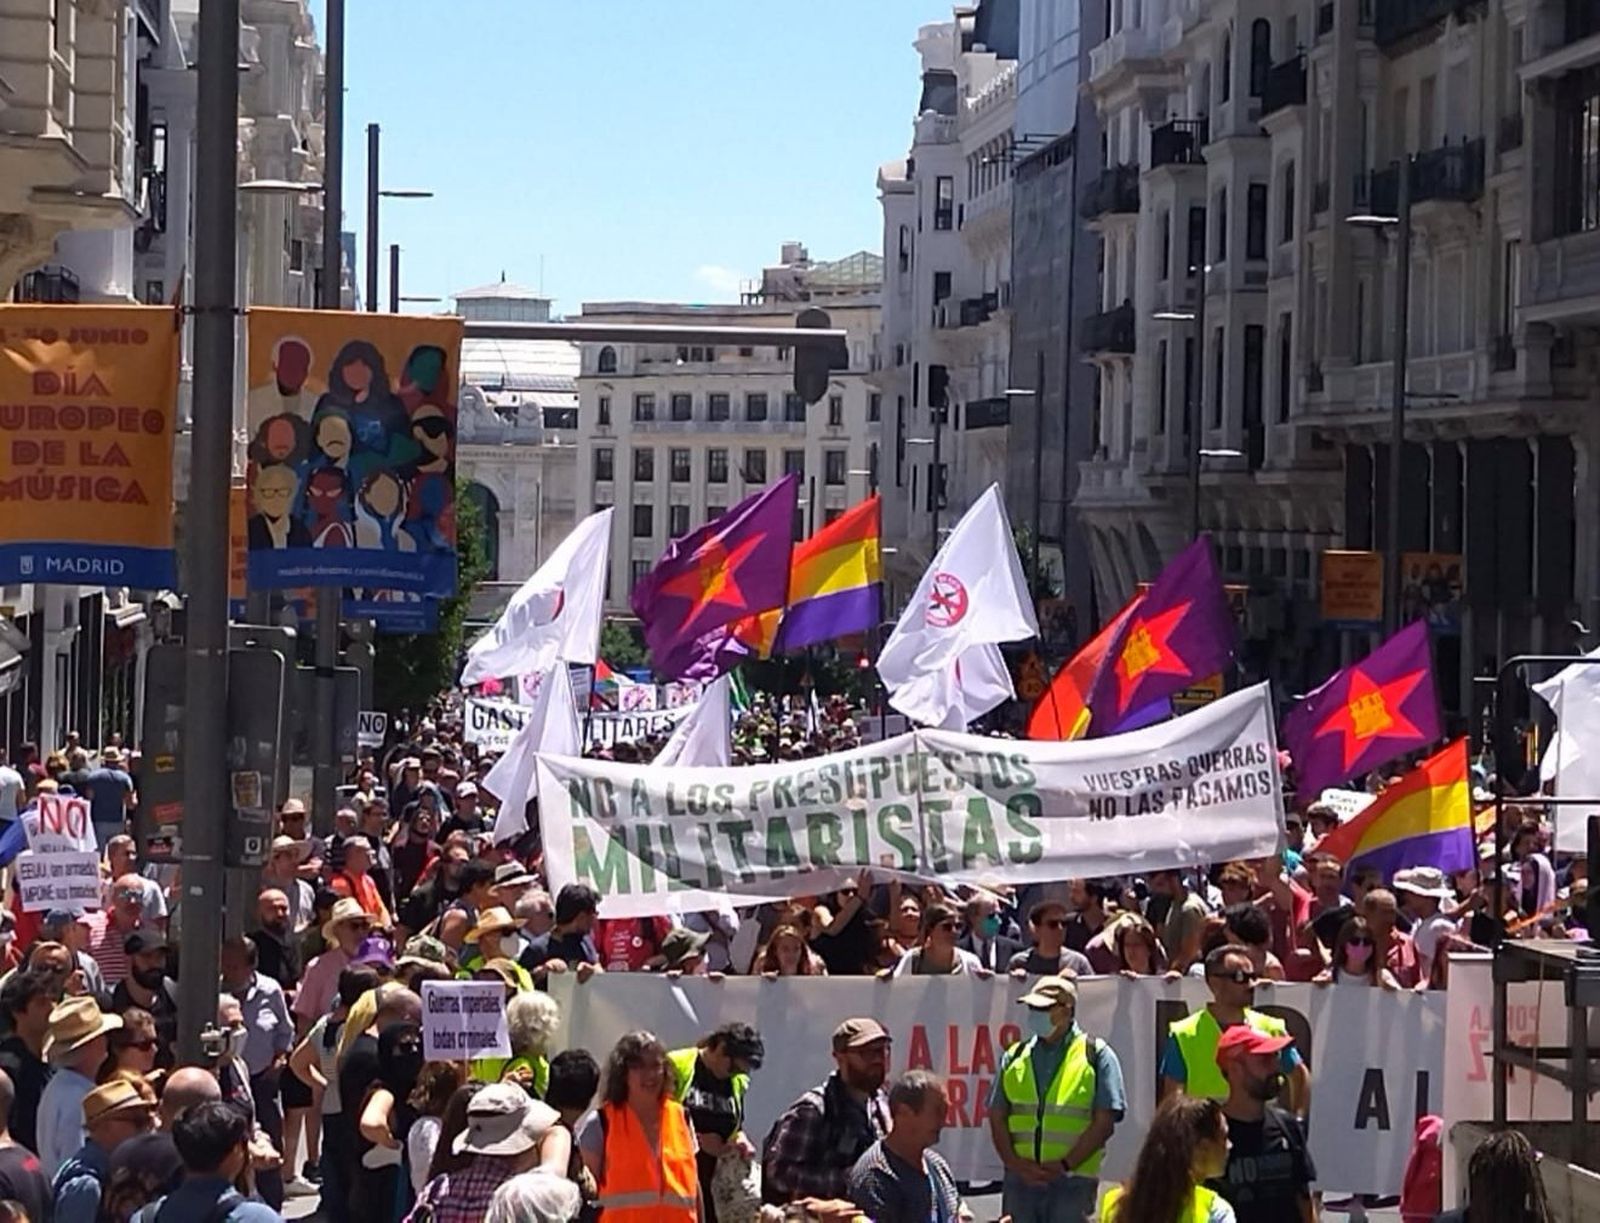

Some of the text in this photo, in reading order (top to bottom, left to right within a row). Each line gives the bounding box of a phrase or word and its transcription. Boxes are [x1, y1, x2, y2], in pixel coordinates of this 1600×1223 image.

[68, 328, 149, 345] JUNIO
[32, 365, 111, 396] DÍA
[0, 405, 165, 435] UROPEO
[12, 440, 132, 467] DE LA
[0, 467, 149, 506] MÚSICA
[45, 557, 124, 575] MADRID
[359, 713, 386, 734] NO
[568, 751, 1038, 819] NO A LOS PRESUPUESTOS
[1083, 759, 1182, 793] VUESTRAS
[39, 796, 87, 839] NO
[1089, 796, 1117, 822] NO
[1125, 789, 1165, 817] LAS
[572, 792, 1044, 896] MILITARISTAS
[908, 1024, 934, 1071] A
